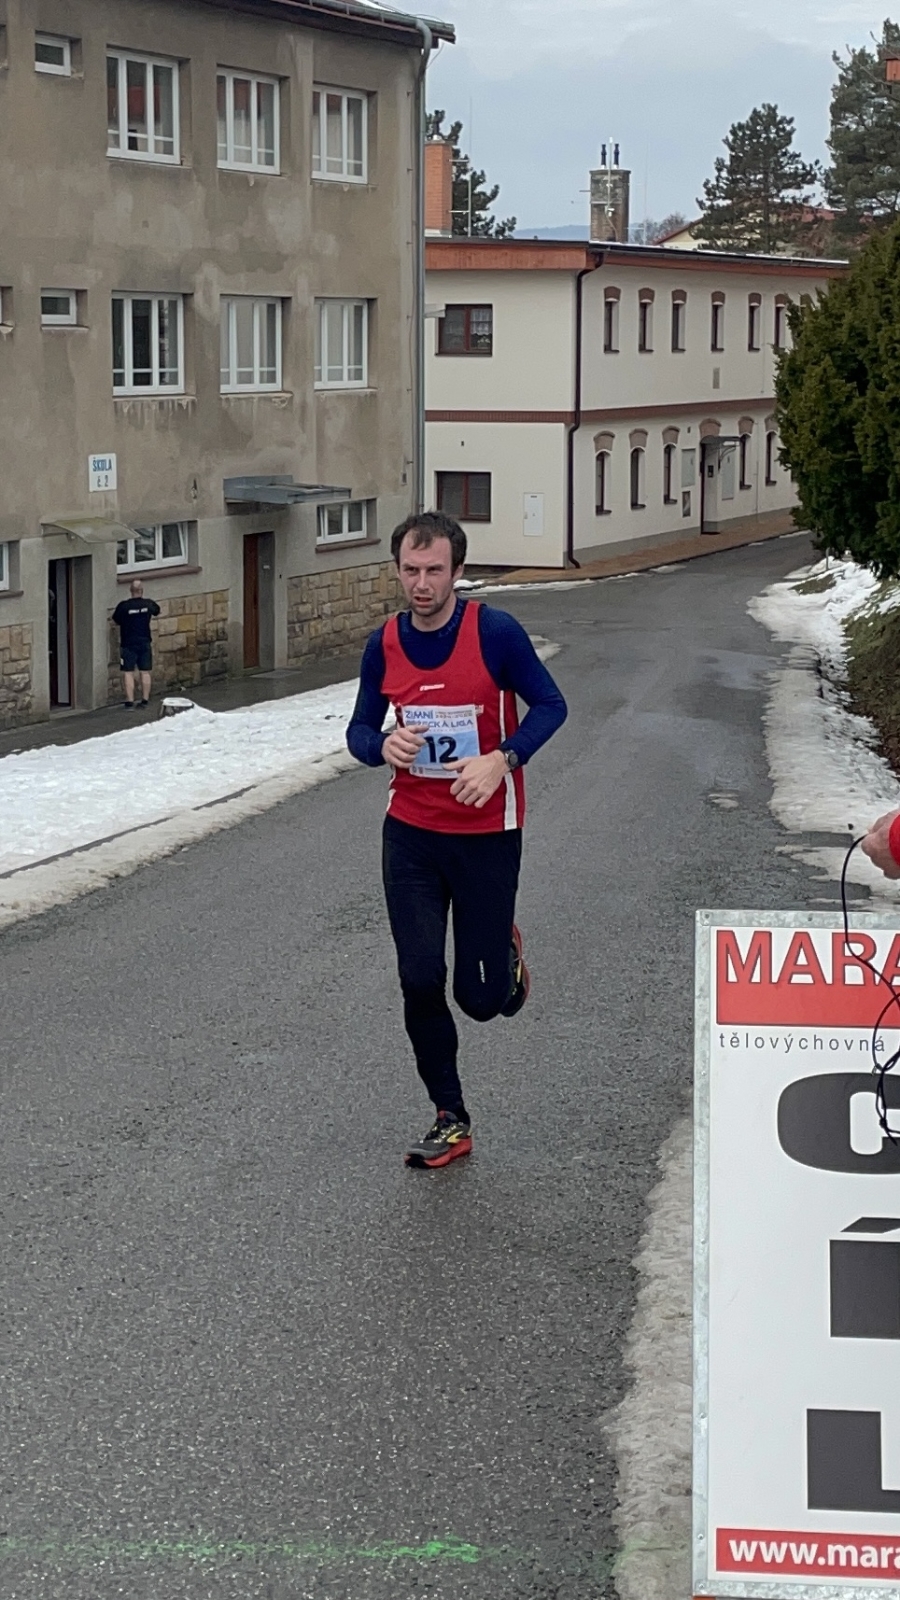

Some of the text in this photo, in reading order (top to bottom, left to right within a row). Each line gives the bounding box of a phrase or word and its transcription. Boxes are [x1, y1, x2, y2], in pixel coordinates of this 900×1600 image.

[92, 456, 112, 472] ŠKOLA
[104, 474, 109, 487] 2
[405, 710, 433, 720] ZIMNÍ
[451, 719, 474, 728] LIGA
[424, 736, 458, 764] 12
[719, 1032, 885, 1054] tělovýchovná
